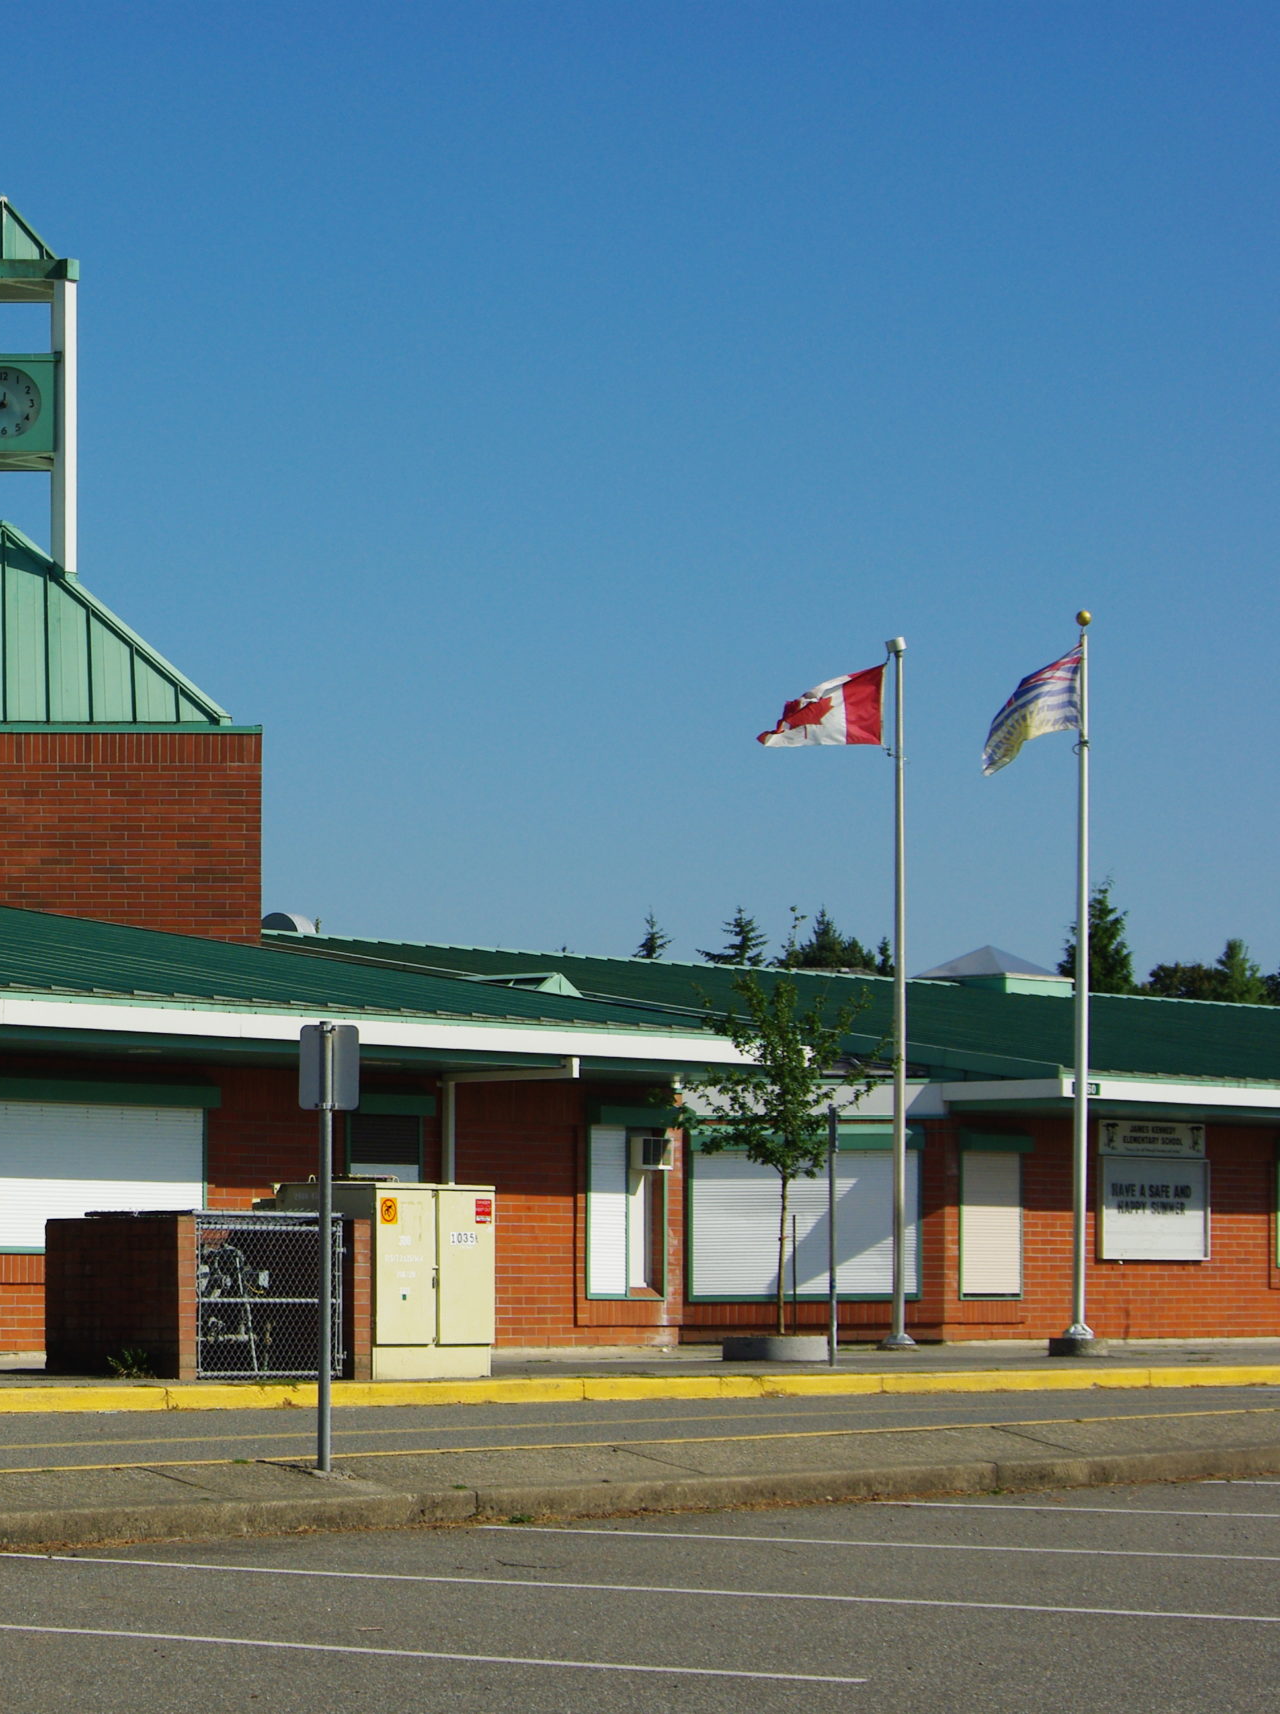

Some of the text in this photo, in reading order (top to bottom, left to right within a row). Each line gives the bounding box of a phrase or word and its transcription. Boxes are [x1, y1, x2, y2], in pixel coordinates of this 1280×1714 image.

[0, 372, 8, 381] 12
[25, 386, 31, 395] 2
[30, 400, 35, 408] 3
[1, 427, 7, 435] 6
[16, 424, 21, 432] 5
[1123, 1136, 1183, 1146] ELEMENTARY SCHOOL
[1111, 1183, 1192, 1199] HAVE A SAFE AND
[1117, 1200, 1186, 1216] HAPPY SUMMER
